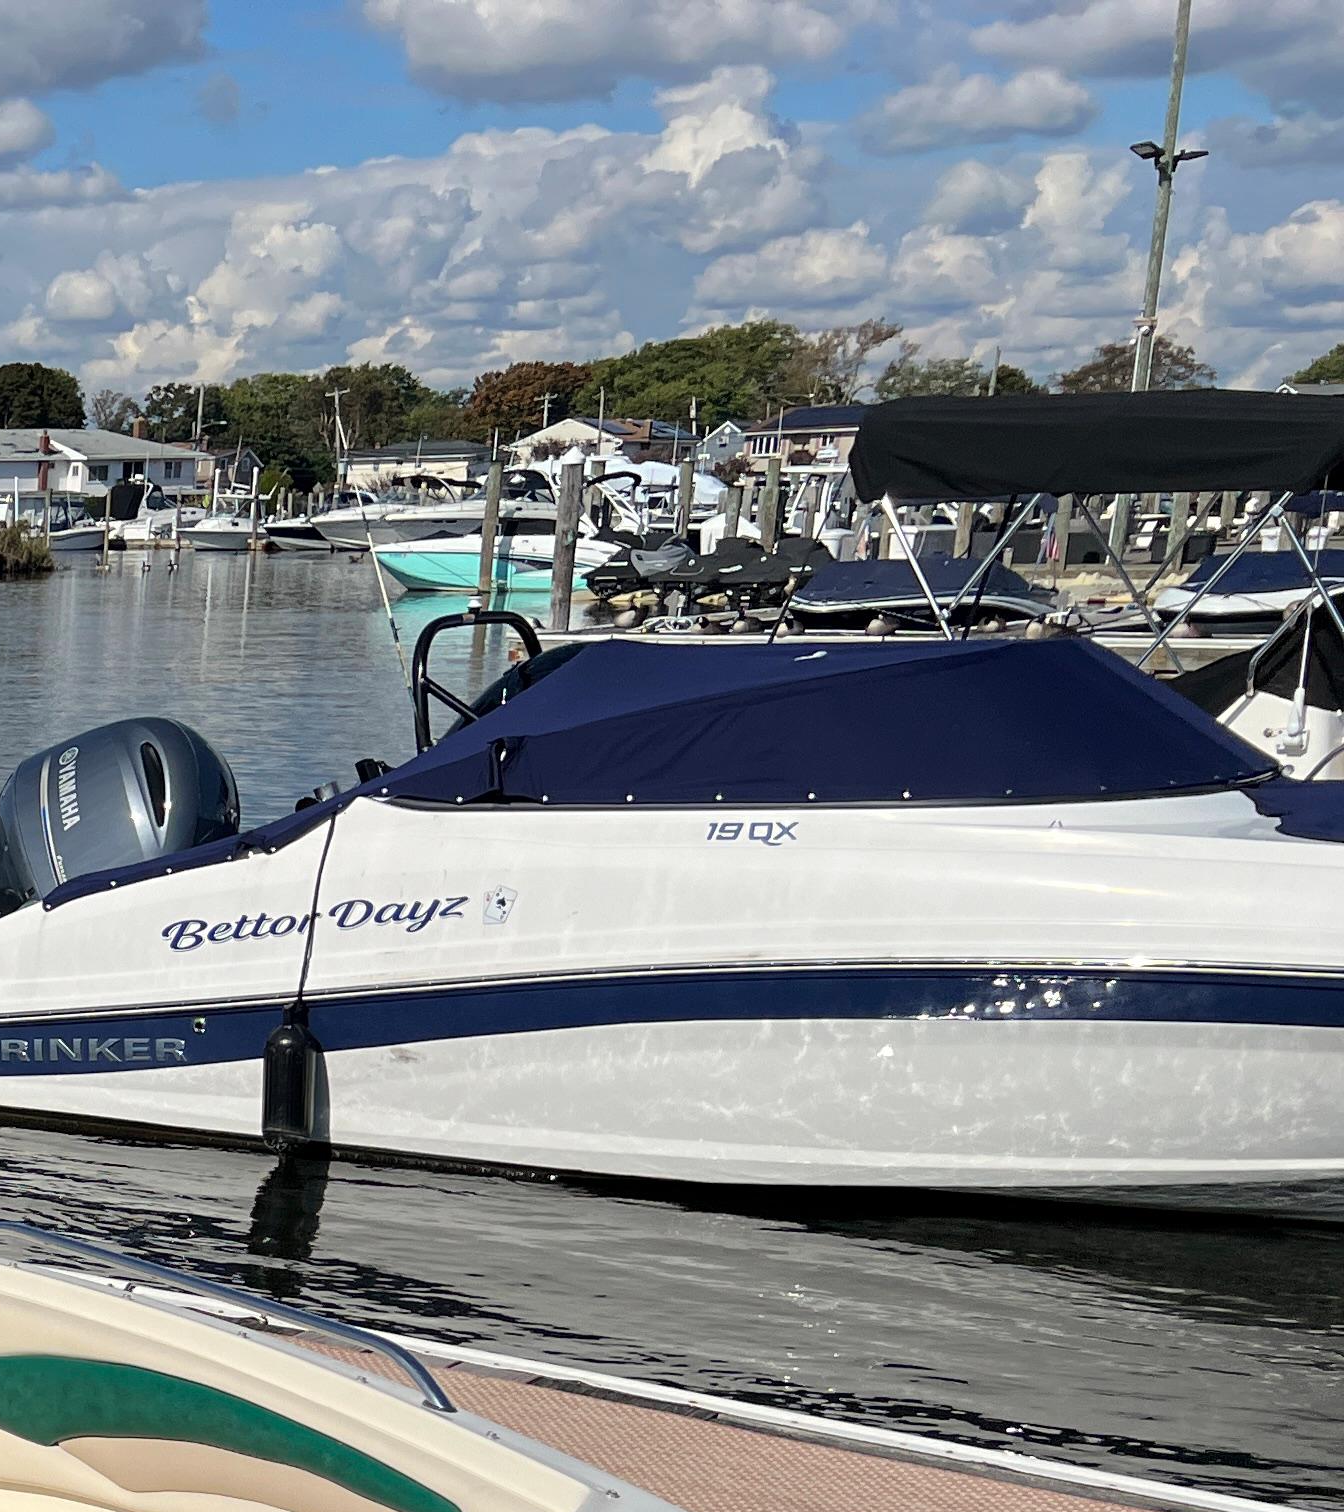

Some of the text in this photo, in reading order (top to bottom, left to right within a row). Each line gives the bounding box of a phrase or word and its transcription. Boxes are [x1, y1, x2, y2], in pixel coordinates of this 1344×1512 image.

[58, 760, 81, 832] YAMAHA
[706, 821, 799, 847] 19 QX
[162, 896, 470, 952] Bettor Dayz
[0, 1037, 188, 1063] RINKER
